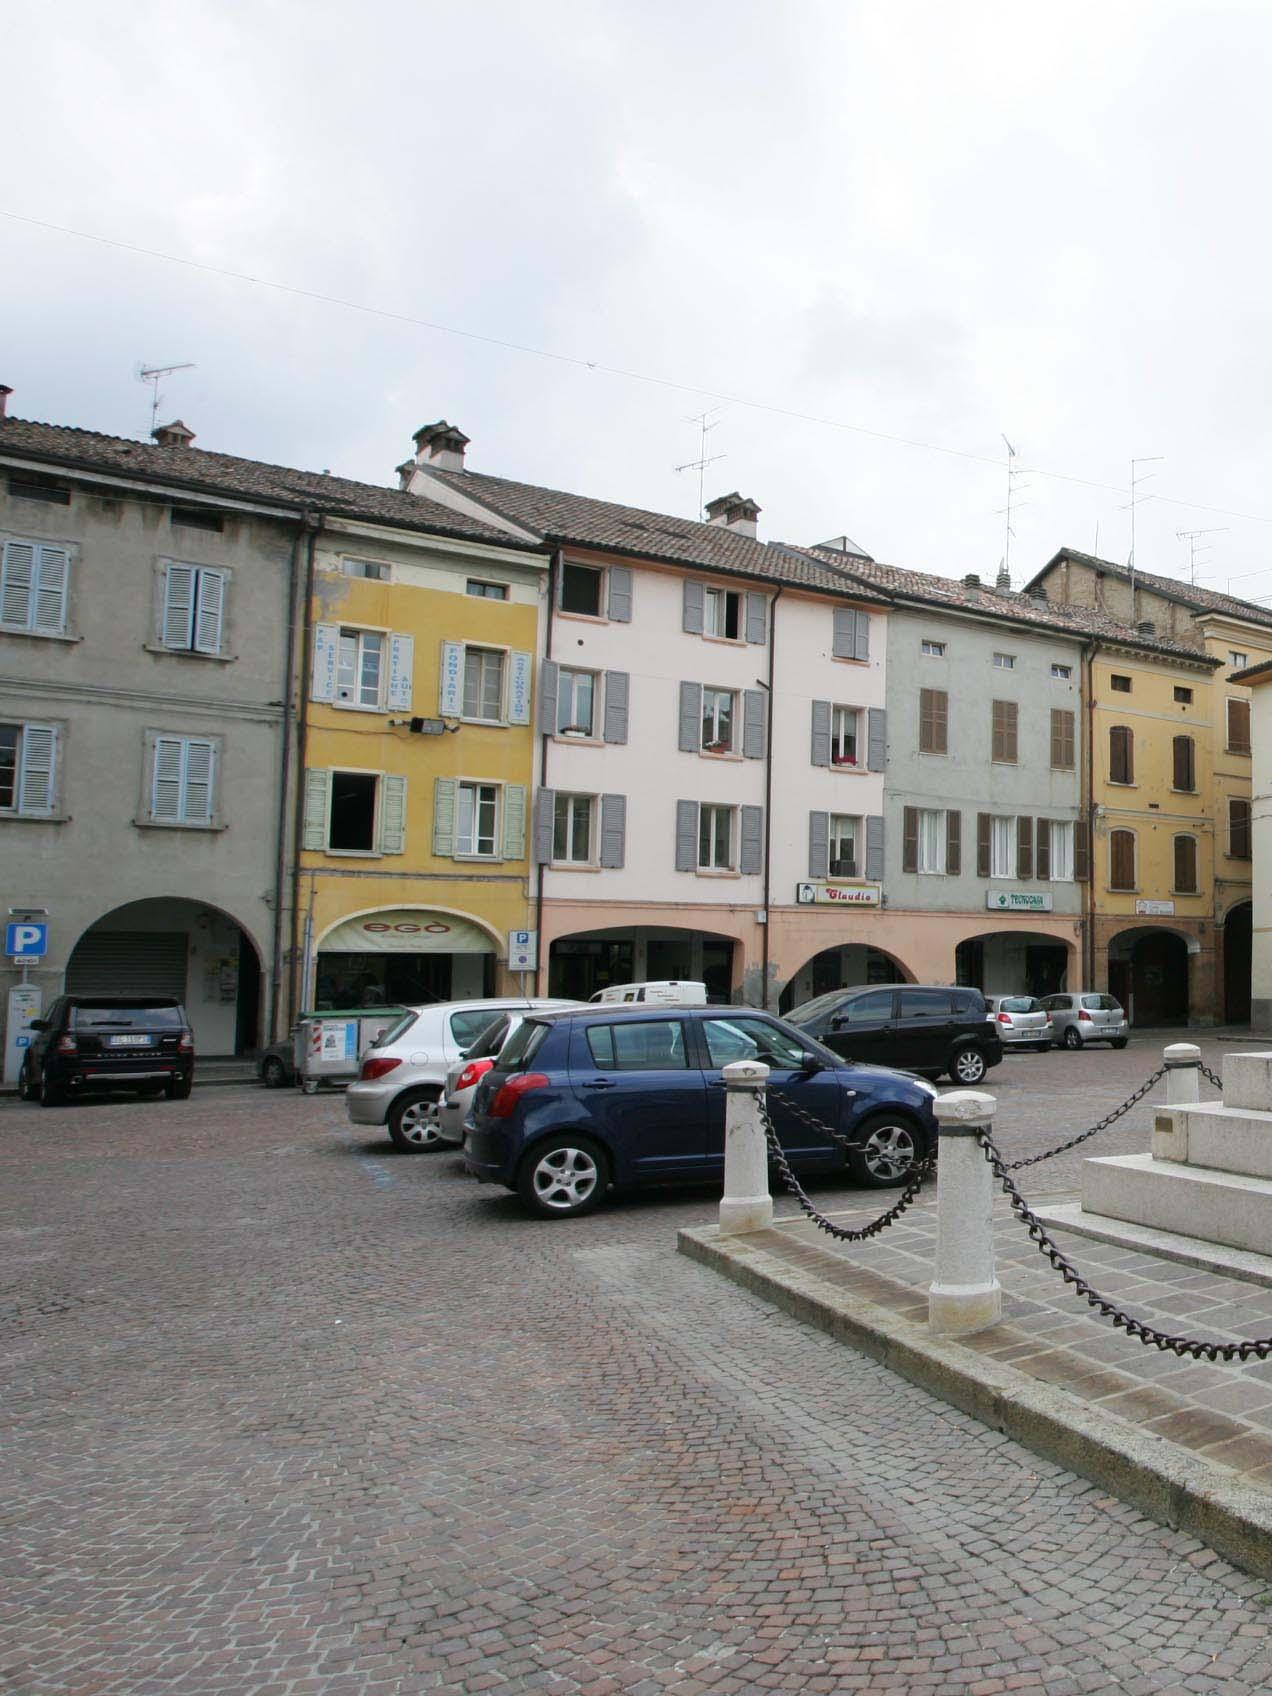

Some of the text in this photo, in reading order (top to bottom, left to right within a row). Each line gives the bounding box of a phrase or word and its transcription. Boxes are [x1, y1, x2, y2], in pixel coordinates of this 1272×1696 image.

[391, 639, 400, 697] PRATICHE
[400, 675, 409, 704] AUTO
[826, 887, 871, 900] Claudio
[15, 926, 42, 953] P
